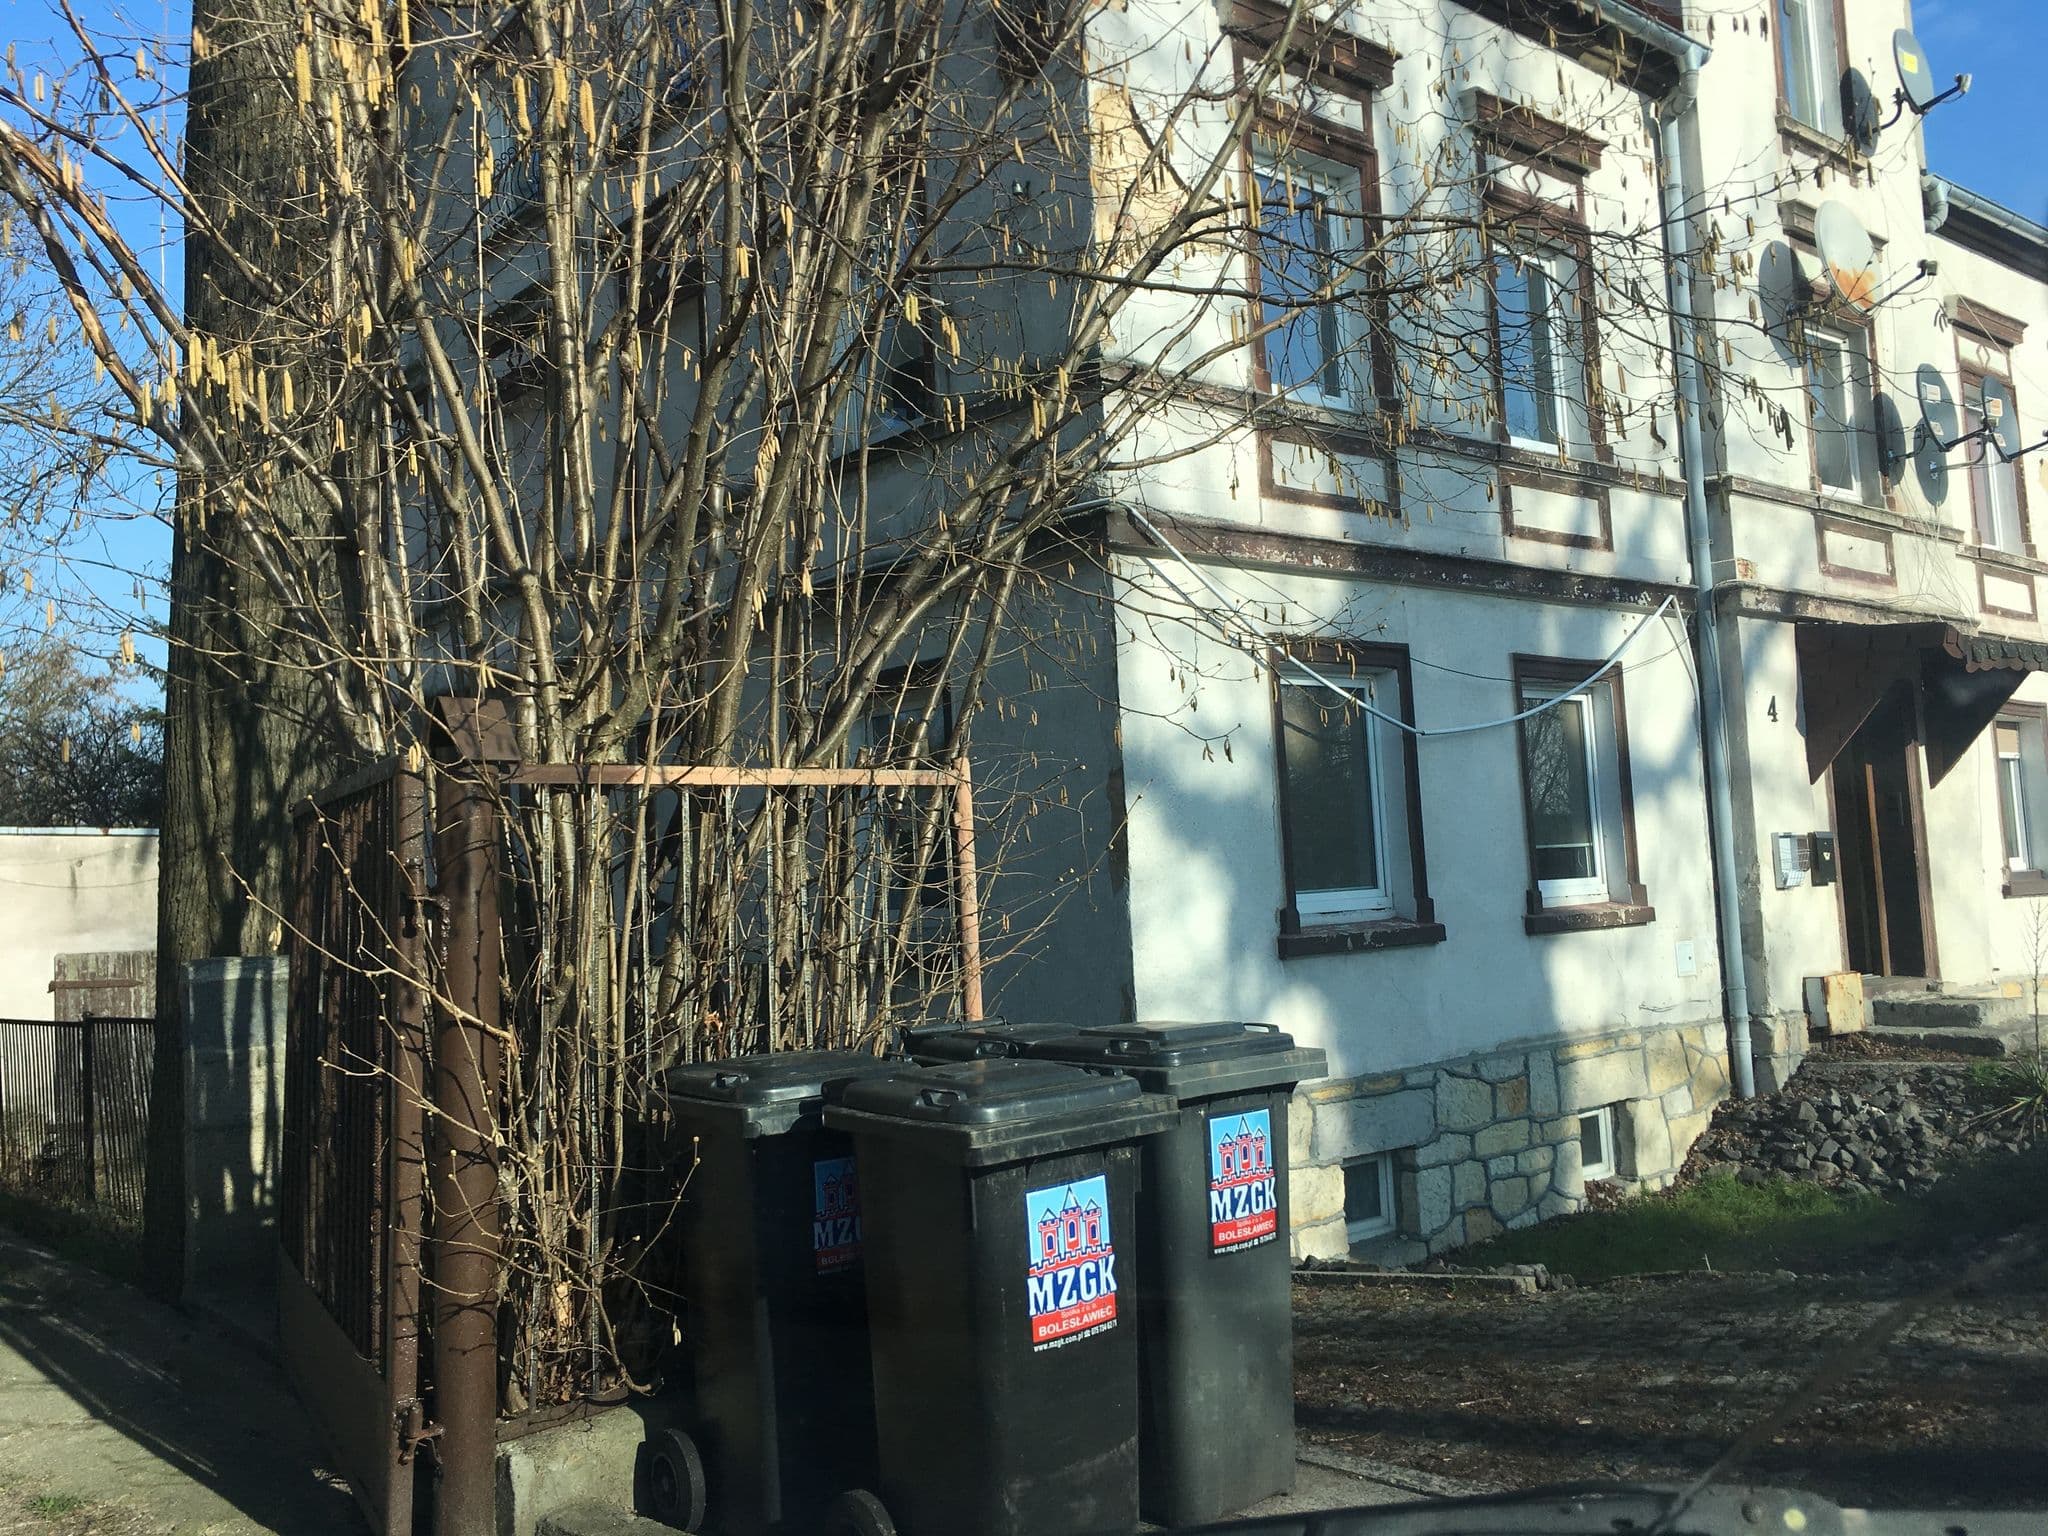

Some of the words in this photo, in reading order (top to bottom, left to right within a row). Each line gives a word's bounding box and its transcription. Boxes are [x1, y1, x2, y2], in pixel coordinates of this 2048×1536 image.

[1767, 695, 1778, 723] 4
[1210, 1177, 1277, 1222] MZGK
[1027, 1254, 1117, 1316] MZGK
[1039, 1305, 1112, 1337] BOLESŁAWIEC
